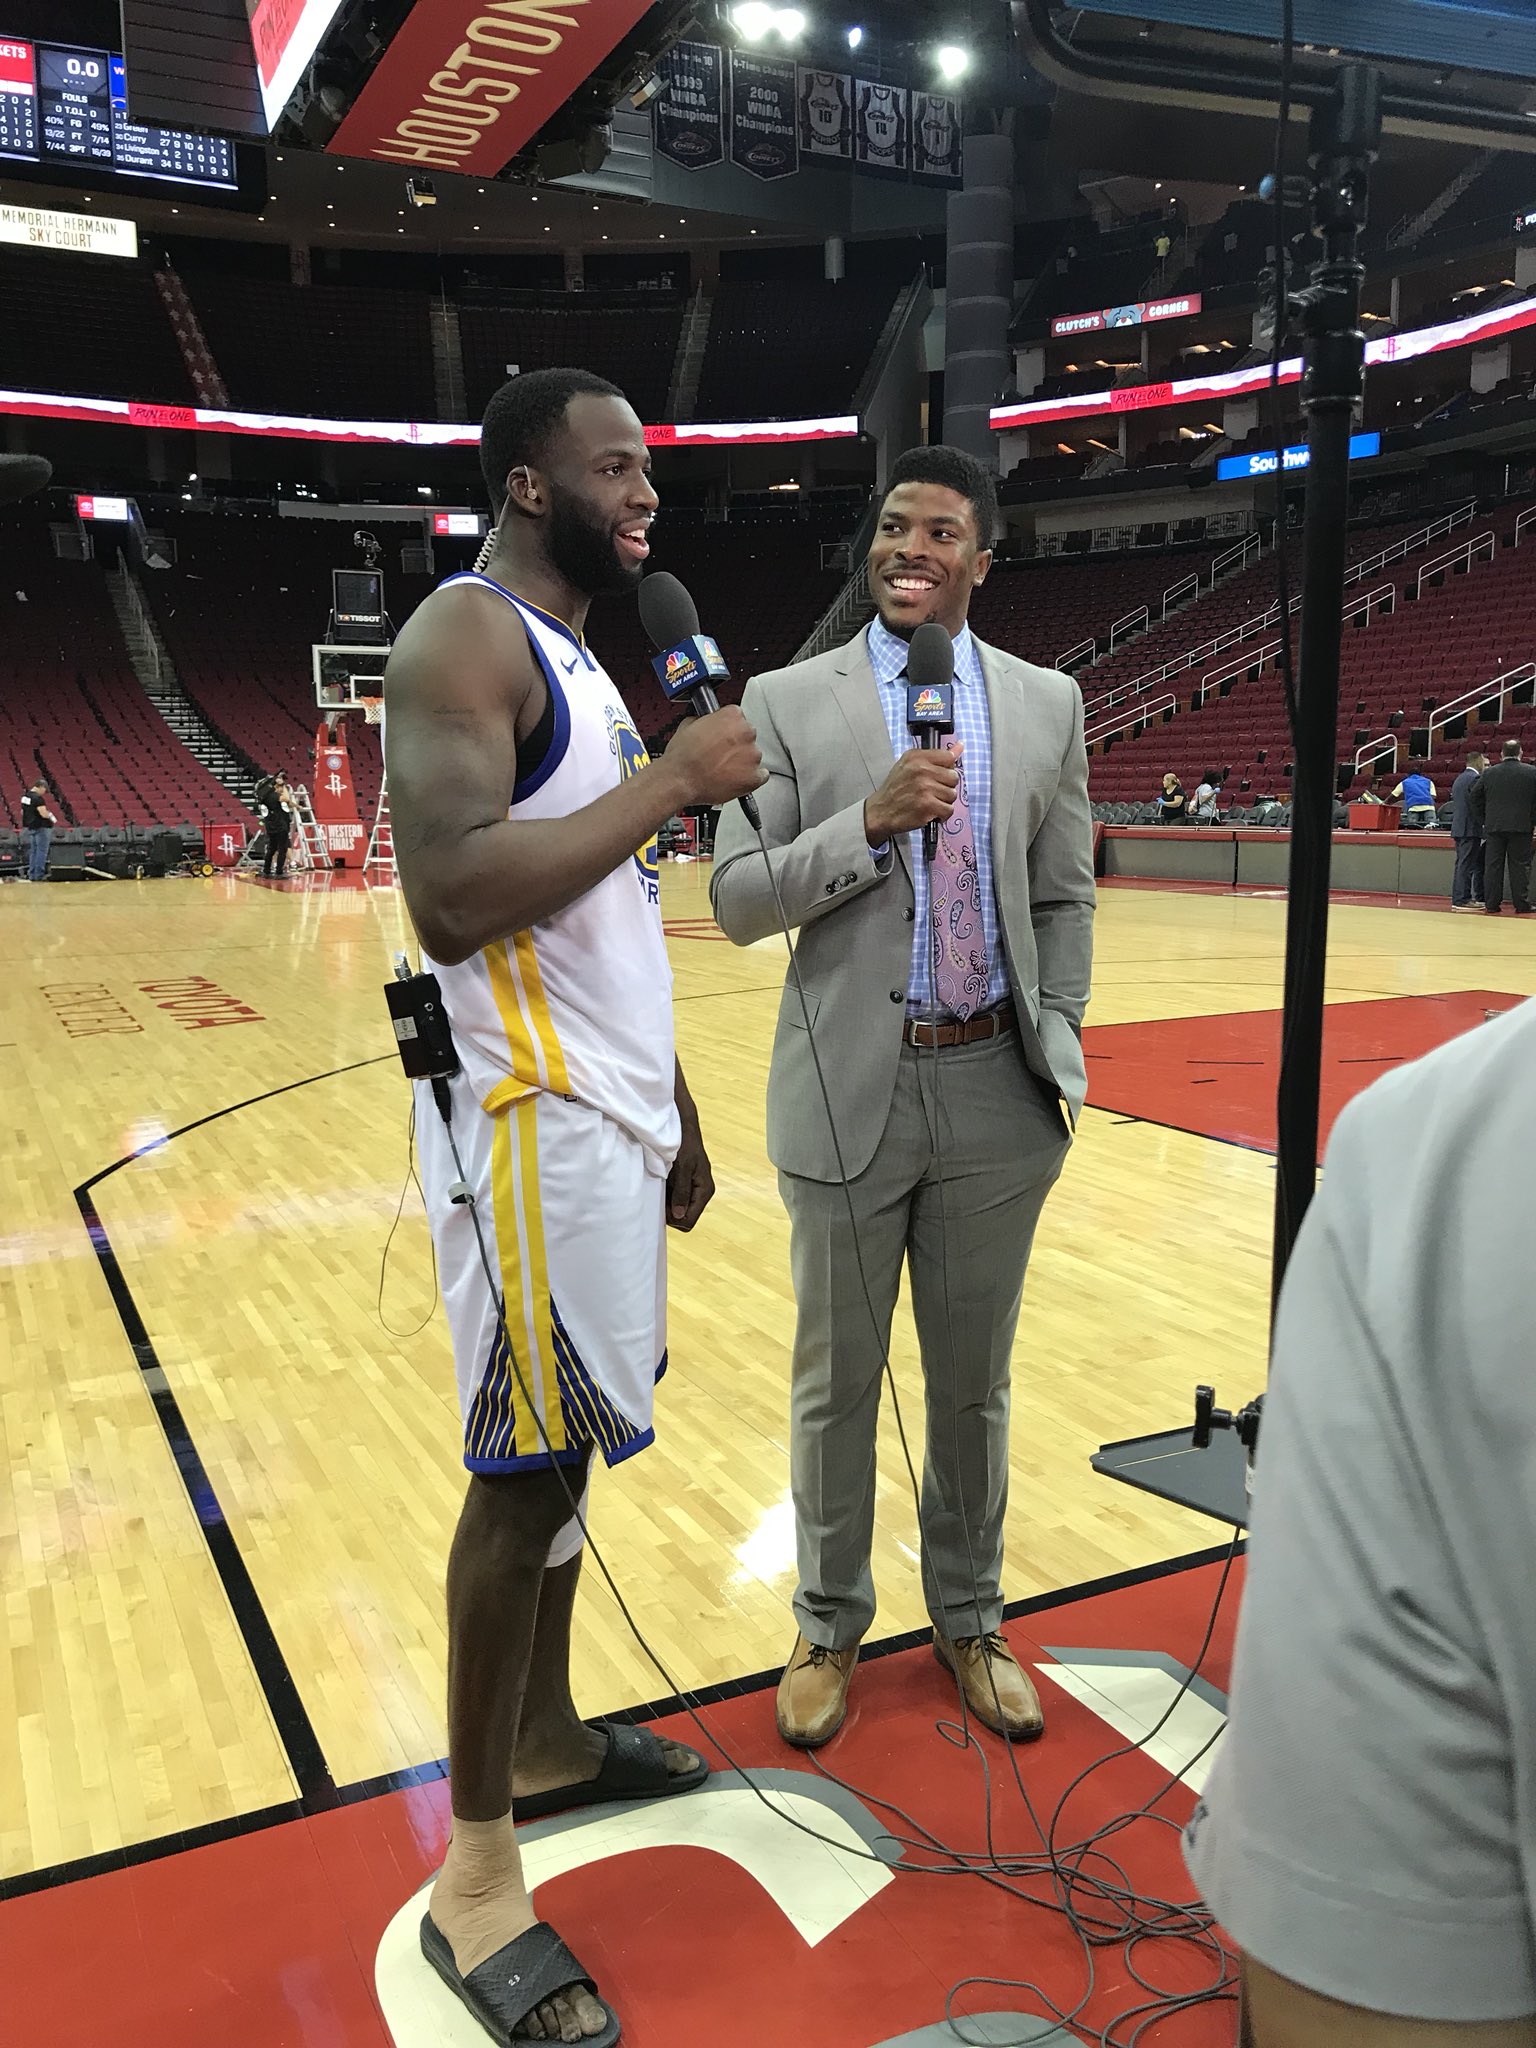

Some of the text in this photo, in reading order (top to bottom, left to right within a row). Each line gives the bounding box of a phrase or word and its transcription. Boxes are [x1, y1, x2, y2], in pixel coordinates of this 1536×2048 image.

[66, 58, 99, 78] 0.0
[12, 96, 18, 104] 0
[24, 98, 30, 106] 4
[62, 92, 88, 104] FOULS
[670, 88, 707, 107] WNBA
[750, 86, 778, 103] 2000
[25, 108, 31, 116] 2
[90, 110, 96, 118] 0
[659, 101, 718, 123] Champions
[747, 101, 782, 119] WNBA
[45, 116, 64, 126] 40%
[70, 120, 82, 128] FG
[736, 115, 793, 136] Champions
[0, 126, 7, 134] 0
[2, 137, 8, 145] 2
[14, 139, 21, 147] 0
[71, 132, 82, 140] FT
[91, 135, 110, 144] 7/14
[123, 133, 147, 144] Curry
[160, 139, 170, 147] 27
[184, 142, 194, 150] 10
[46, 142, 65, 151] 7/44
[124, 144, 160, 155] Livingston
[198, 154, 204, 162] 0
[209, 156, 216, 164] 0
[125, 154, 153, 166] Durant
[160, 160, 172, 168] 34
[175, 162, 182, 170] 5
[186, 163, 193, 172] 5
[210, 167, 217, 175] 3
[222, 168, 229, 176] 3
[2, 210, 117, 235] MEMORIAL HERMANN
[29, 228, 91, 248] SKY COURT
[1056, 300, 1189, 333] CLUTCH'S CORNER
[1147, 387, 1168, 400] ONE
[169, 411, 192, 421] ONE
[652, 430, 671, 439] ONE
[1250, 450, 1310, 473] Souhw
[350, 614, 381, 623] TISSOT
[665, 660, 696, 684] Sports
[672, 670, 698, 689] BAY AREA
[913, 702, 946, 712] Sports
[328, 824, 363, 838] WESTERN
[328, 838, 355, 850] FINALS
[39, 982, 144, 1038] CENTER
[132, 976, 266, 1030] TOYOTA
[508, 1974, 520, 1986] 23
